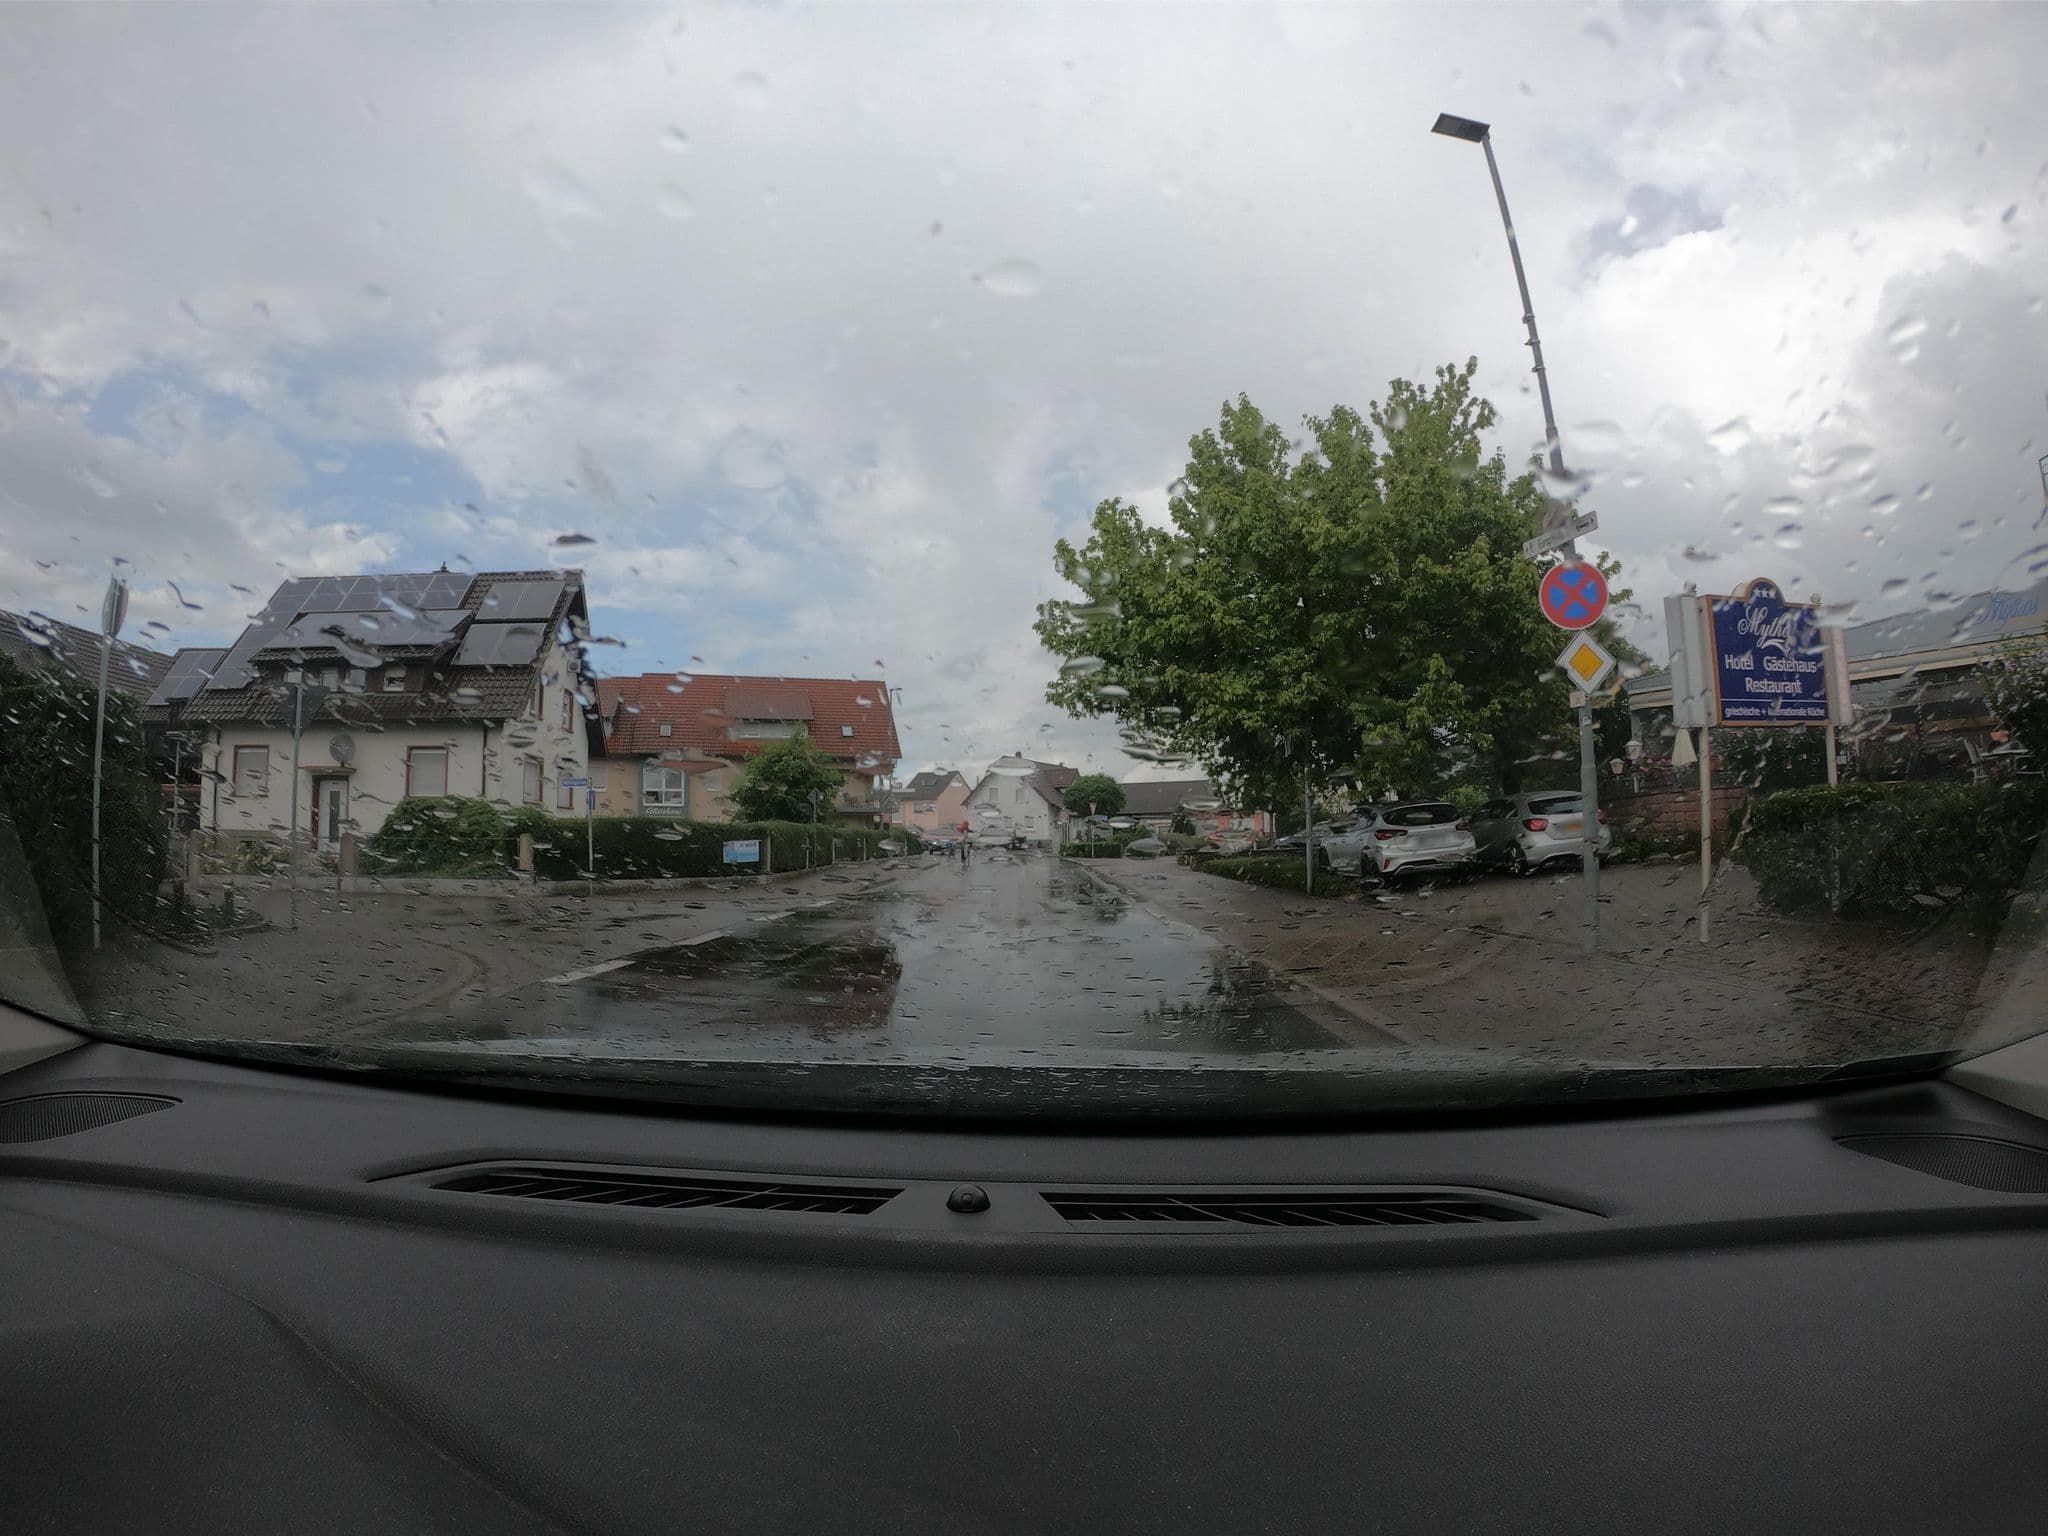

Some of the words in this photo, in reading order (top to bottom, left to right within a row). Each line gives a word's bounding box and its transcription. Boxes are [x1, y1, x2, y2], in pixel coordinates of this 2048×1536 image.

[1724, 654, 1754, 671] Hotel
[1763, 655, 1818, 673] Gästehaus
[1744, 677, 1803, 695] Restaurant
